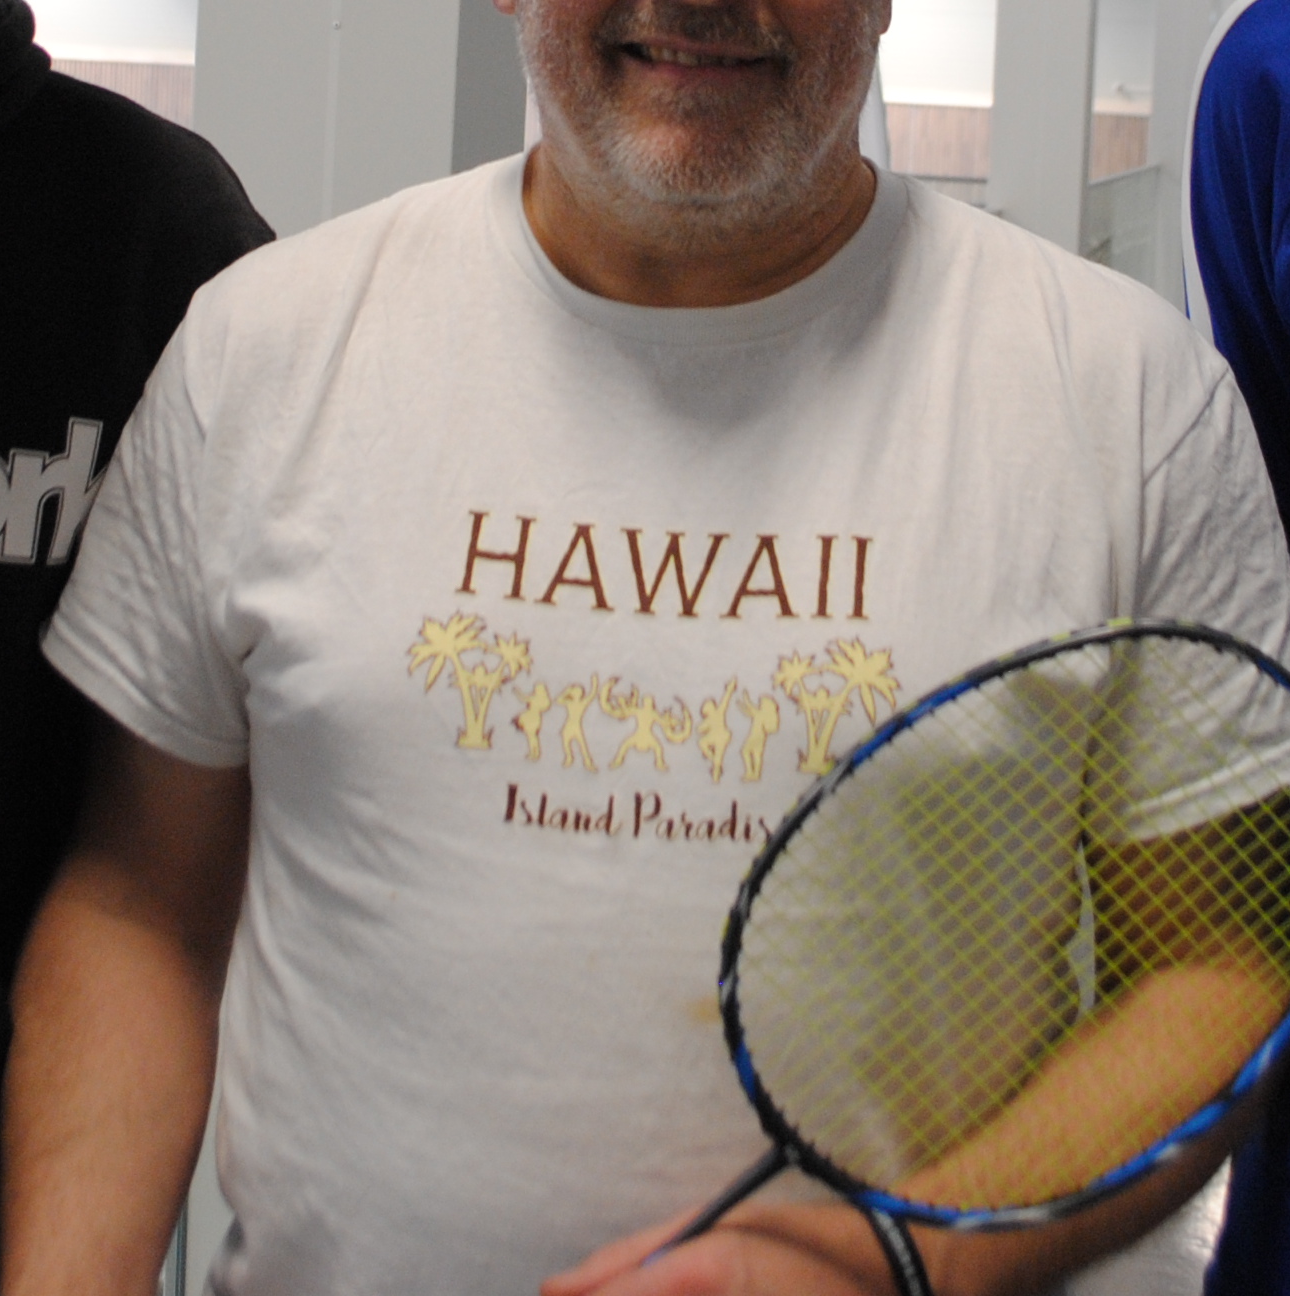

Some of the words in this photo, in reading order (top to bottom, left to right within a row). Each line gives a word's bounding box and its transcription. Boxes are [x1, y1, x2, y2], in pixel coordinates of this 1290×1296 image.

[455, 510, 874, 620] HAWAII
[503, 783, 621, 836] Island
[633, 790, 775, 843] Paradis
